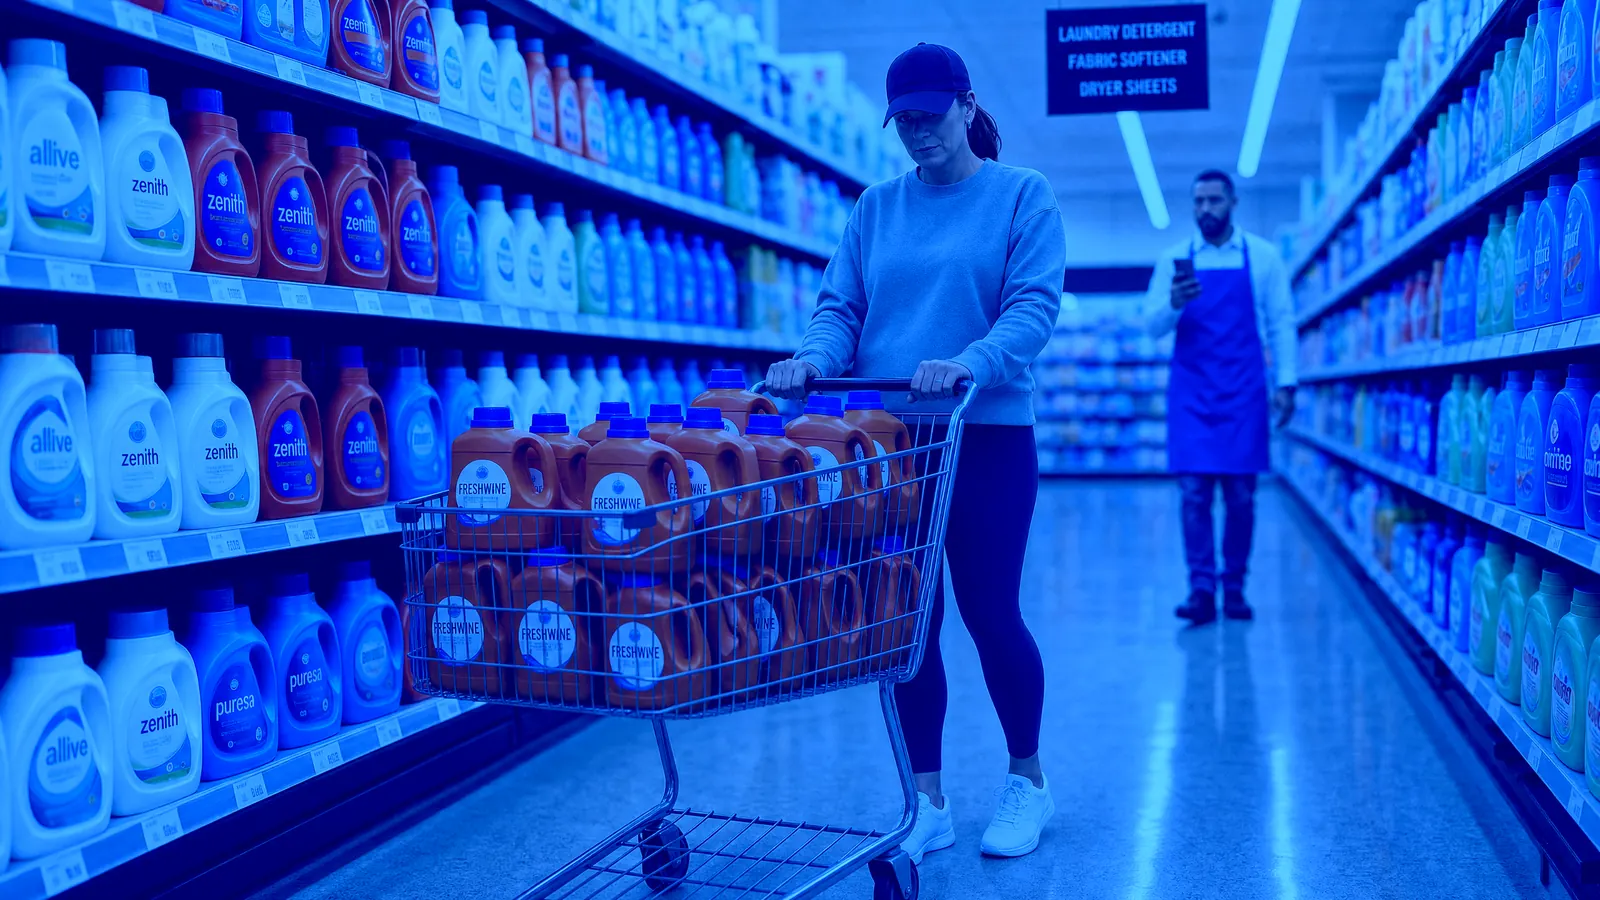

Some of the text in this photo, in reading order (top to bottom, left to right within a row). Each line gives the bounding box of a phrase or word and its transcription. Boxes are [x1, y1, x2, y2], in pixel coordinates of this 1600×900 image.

[1058, 21, 1196, 43] LAUNDRY DETERGENT
[1068, 49, 1187, 70] FABRIC SOFTENER
[1079, 77, 1177, 97] DRYER SHEETS
[29, 138, 80, 171] allive
[132, 177, 169, 197] zenith
[207, 193, 245, 215] zenith
[277, 206, 314, 226] zenith
[345, 214, 377, 234] zenith
[30, 427, 73, 454] allive
[273, 438, 307, 458] zenith
[347, 435, 378, 455] zenith
[121, 447, 159, 467] zenith
[205, 443, 239, 460] zenith
[458, 483, 507, 495] FRESHWINE
[433, 621, 480, 635] FRESHWINE
[521, 627, 572, 641] FRESHWINE
[611, 645, 660, 660] FRESHWINE
[290, 667, 323, 693] puresa
[215, 694, 255, 722] puresa
[140, 708, 179, 735] zenith
[45, 736, 89, 766] allive
